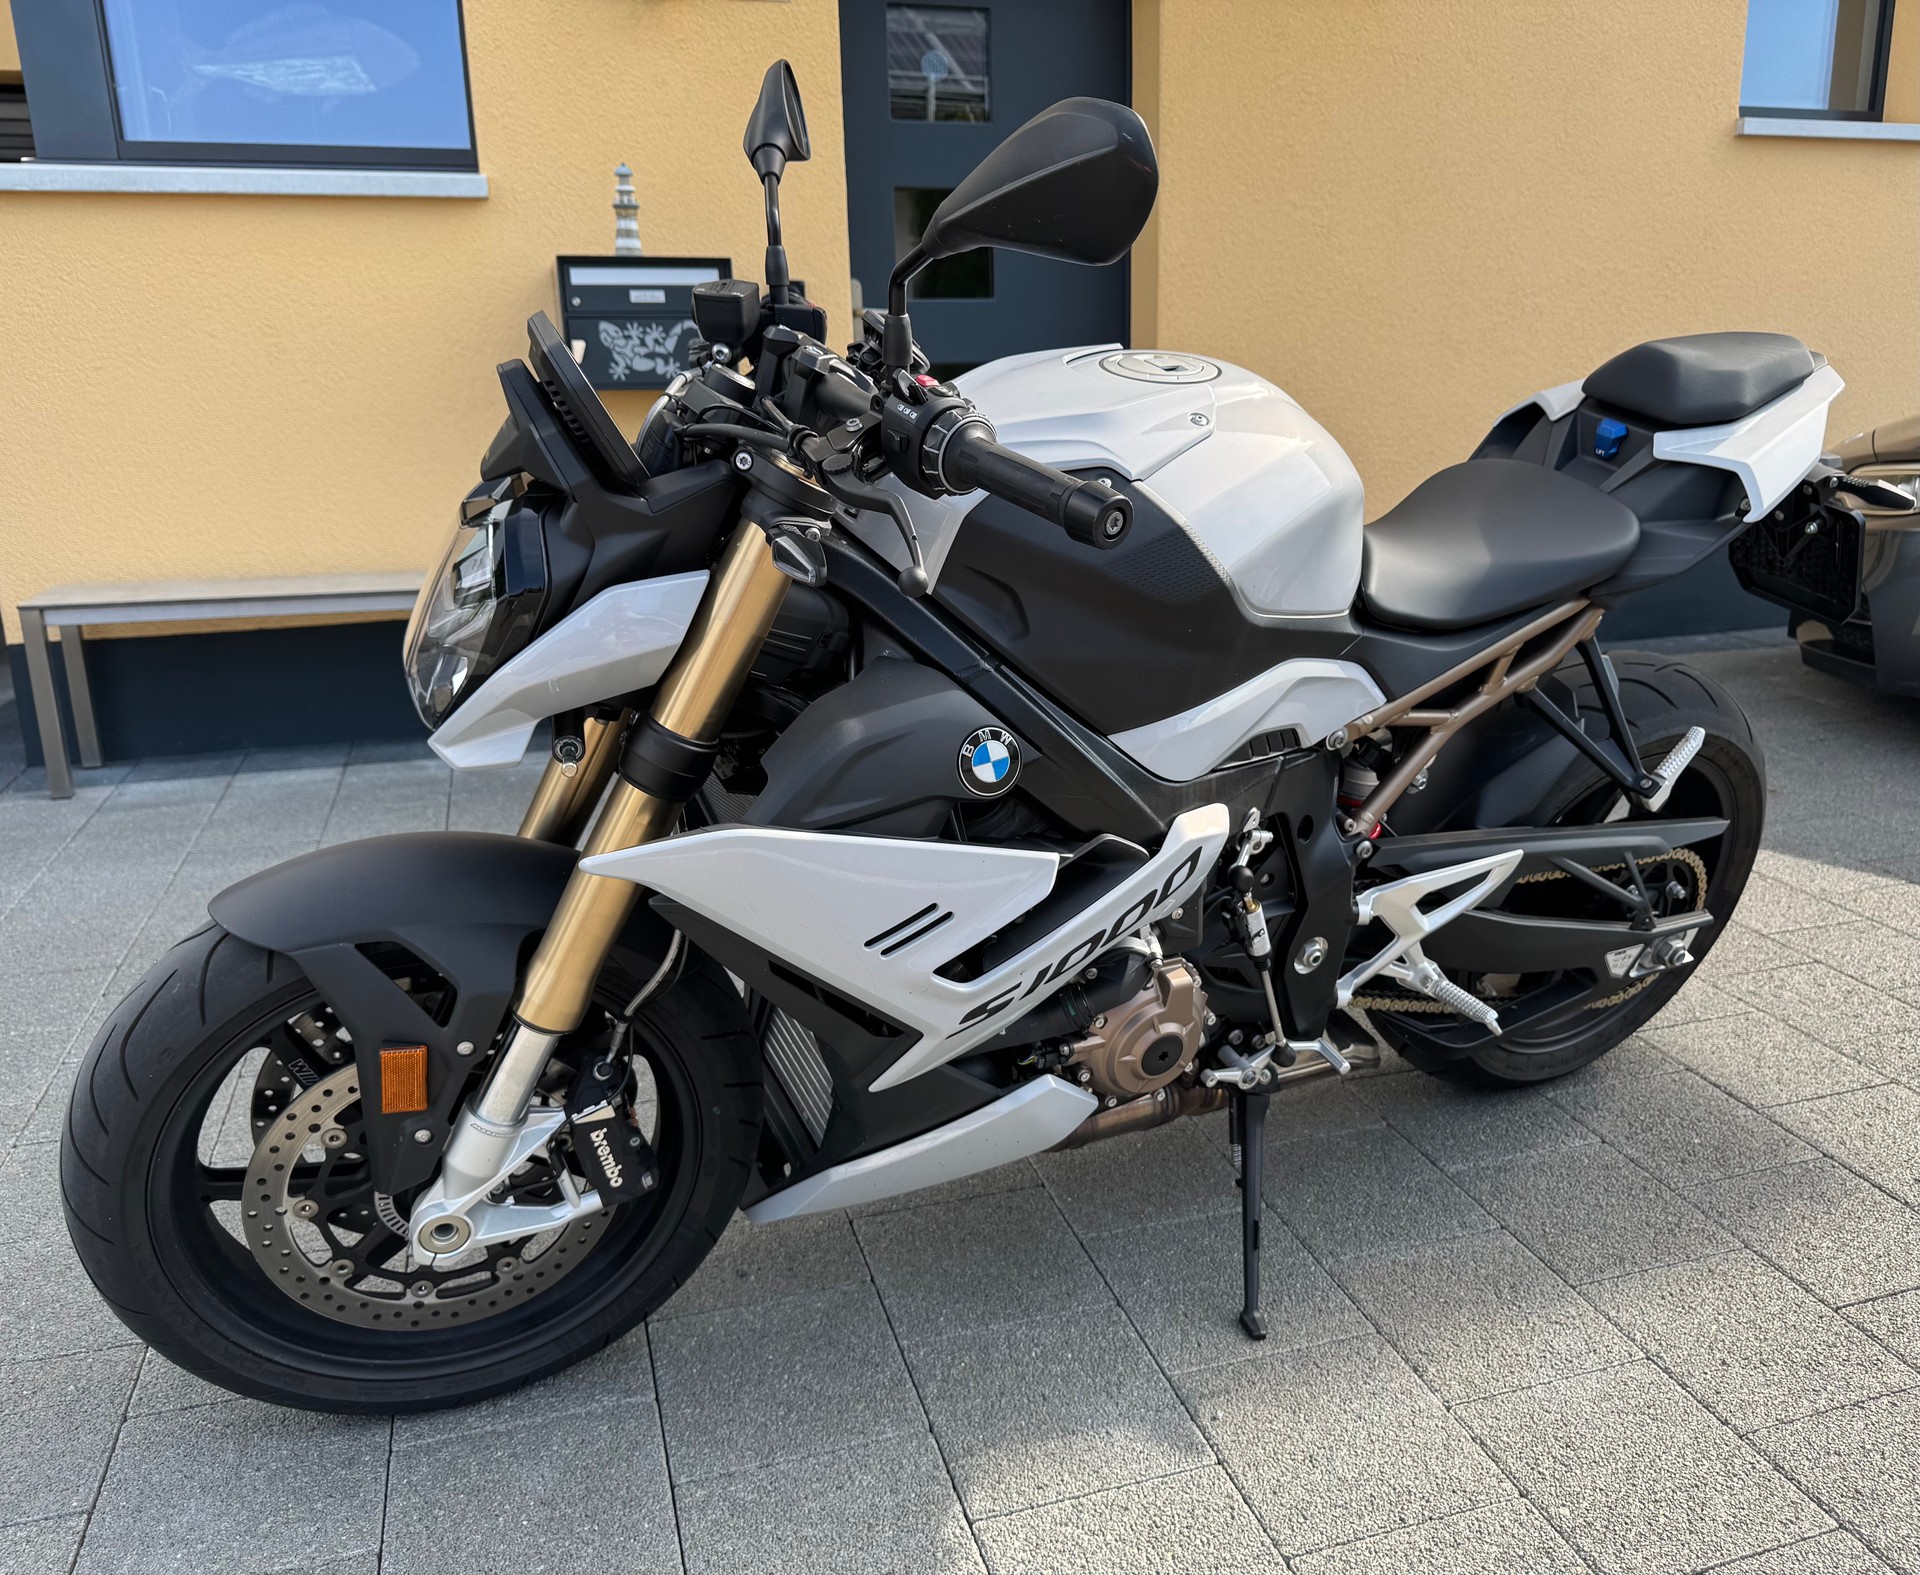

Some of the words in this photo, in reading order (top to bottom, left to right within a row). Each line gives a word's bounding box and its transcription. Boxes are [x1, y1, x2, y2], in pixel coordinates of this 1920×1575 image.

[962, 729, 1012, 758] BMW
[945, 846, 1203, 1040] S1000
[590, 1127, 623, 1188] brembo
